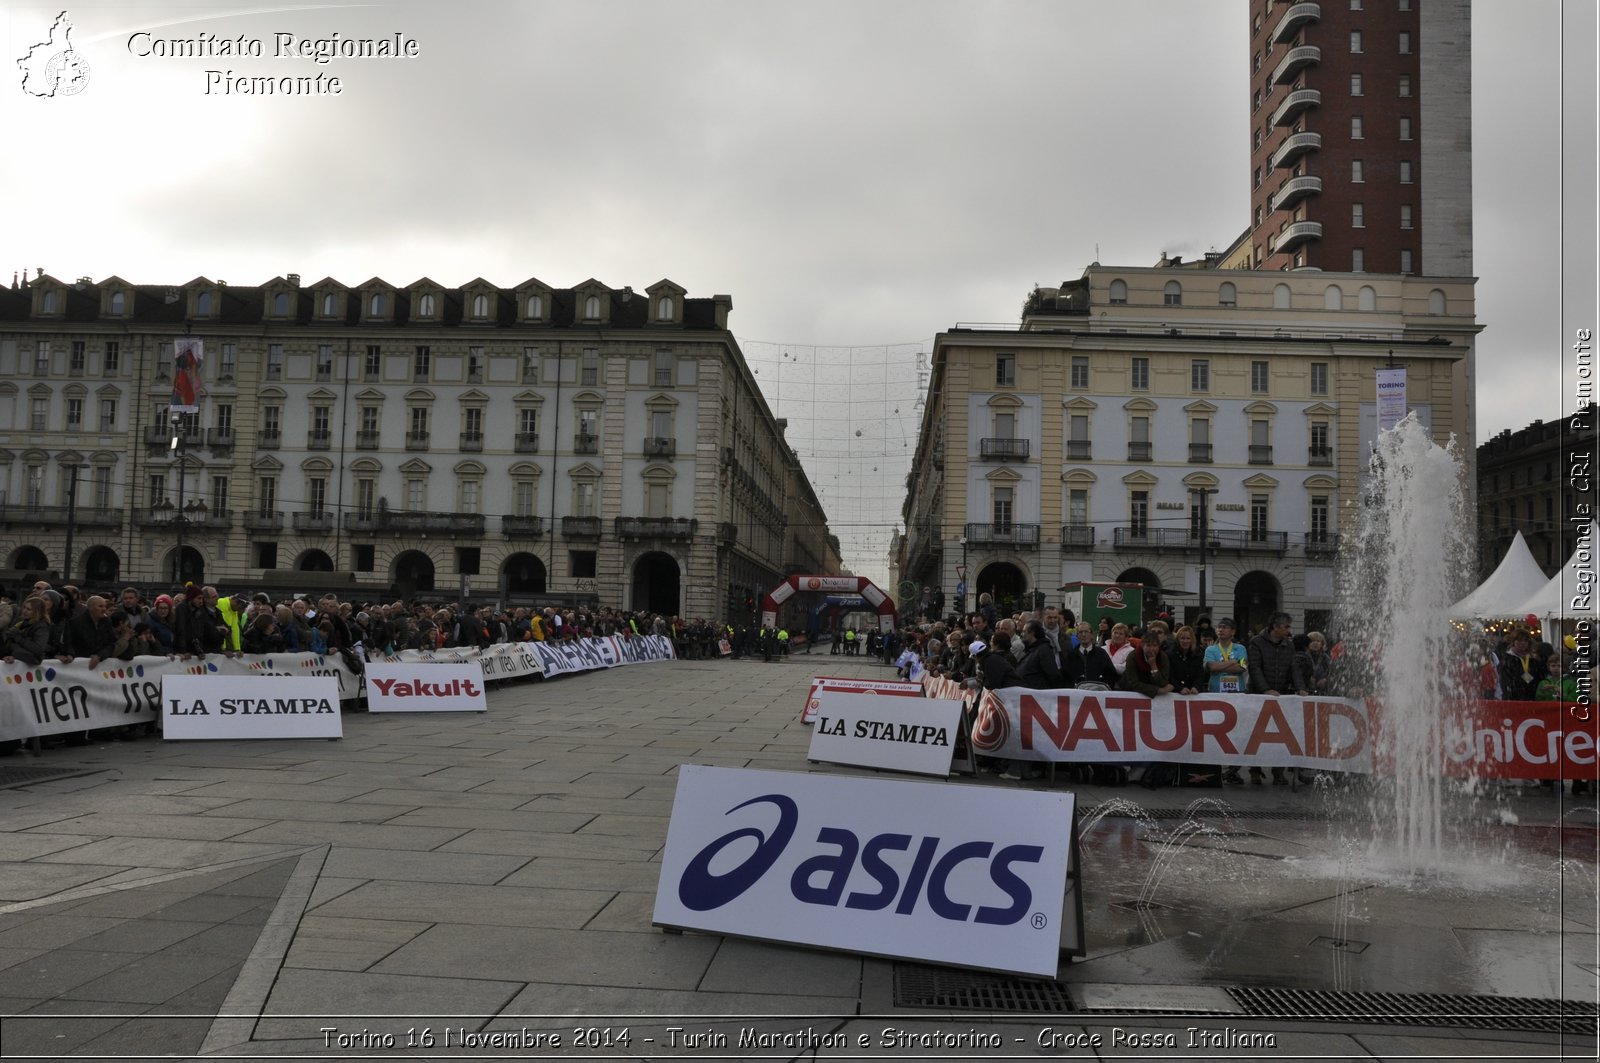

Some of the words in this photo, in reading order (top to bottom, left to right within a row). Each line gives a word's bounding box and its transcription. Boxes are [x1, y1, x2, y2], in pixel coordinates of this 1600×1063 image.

[1156, 502, 1185, 510] REALE
[1216, 503, 1246, 511] MUTUA
[122, 681, 162, 714] ire
[371, 678, 481, 697] Yakult
[169, 699, 210, 715] LA
[220, 698, 335, 715] STAMPA
[817, 716, 847, 737] LA
[853, 719, 949, 747] STAMPA
[1020, 694, 1370, 761] NATURAID
[1445, 717, 1600, 765] UniCre
[790, 827, 1045, 926] asics
